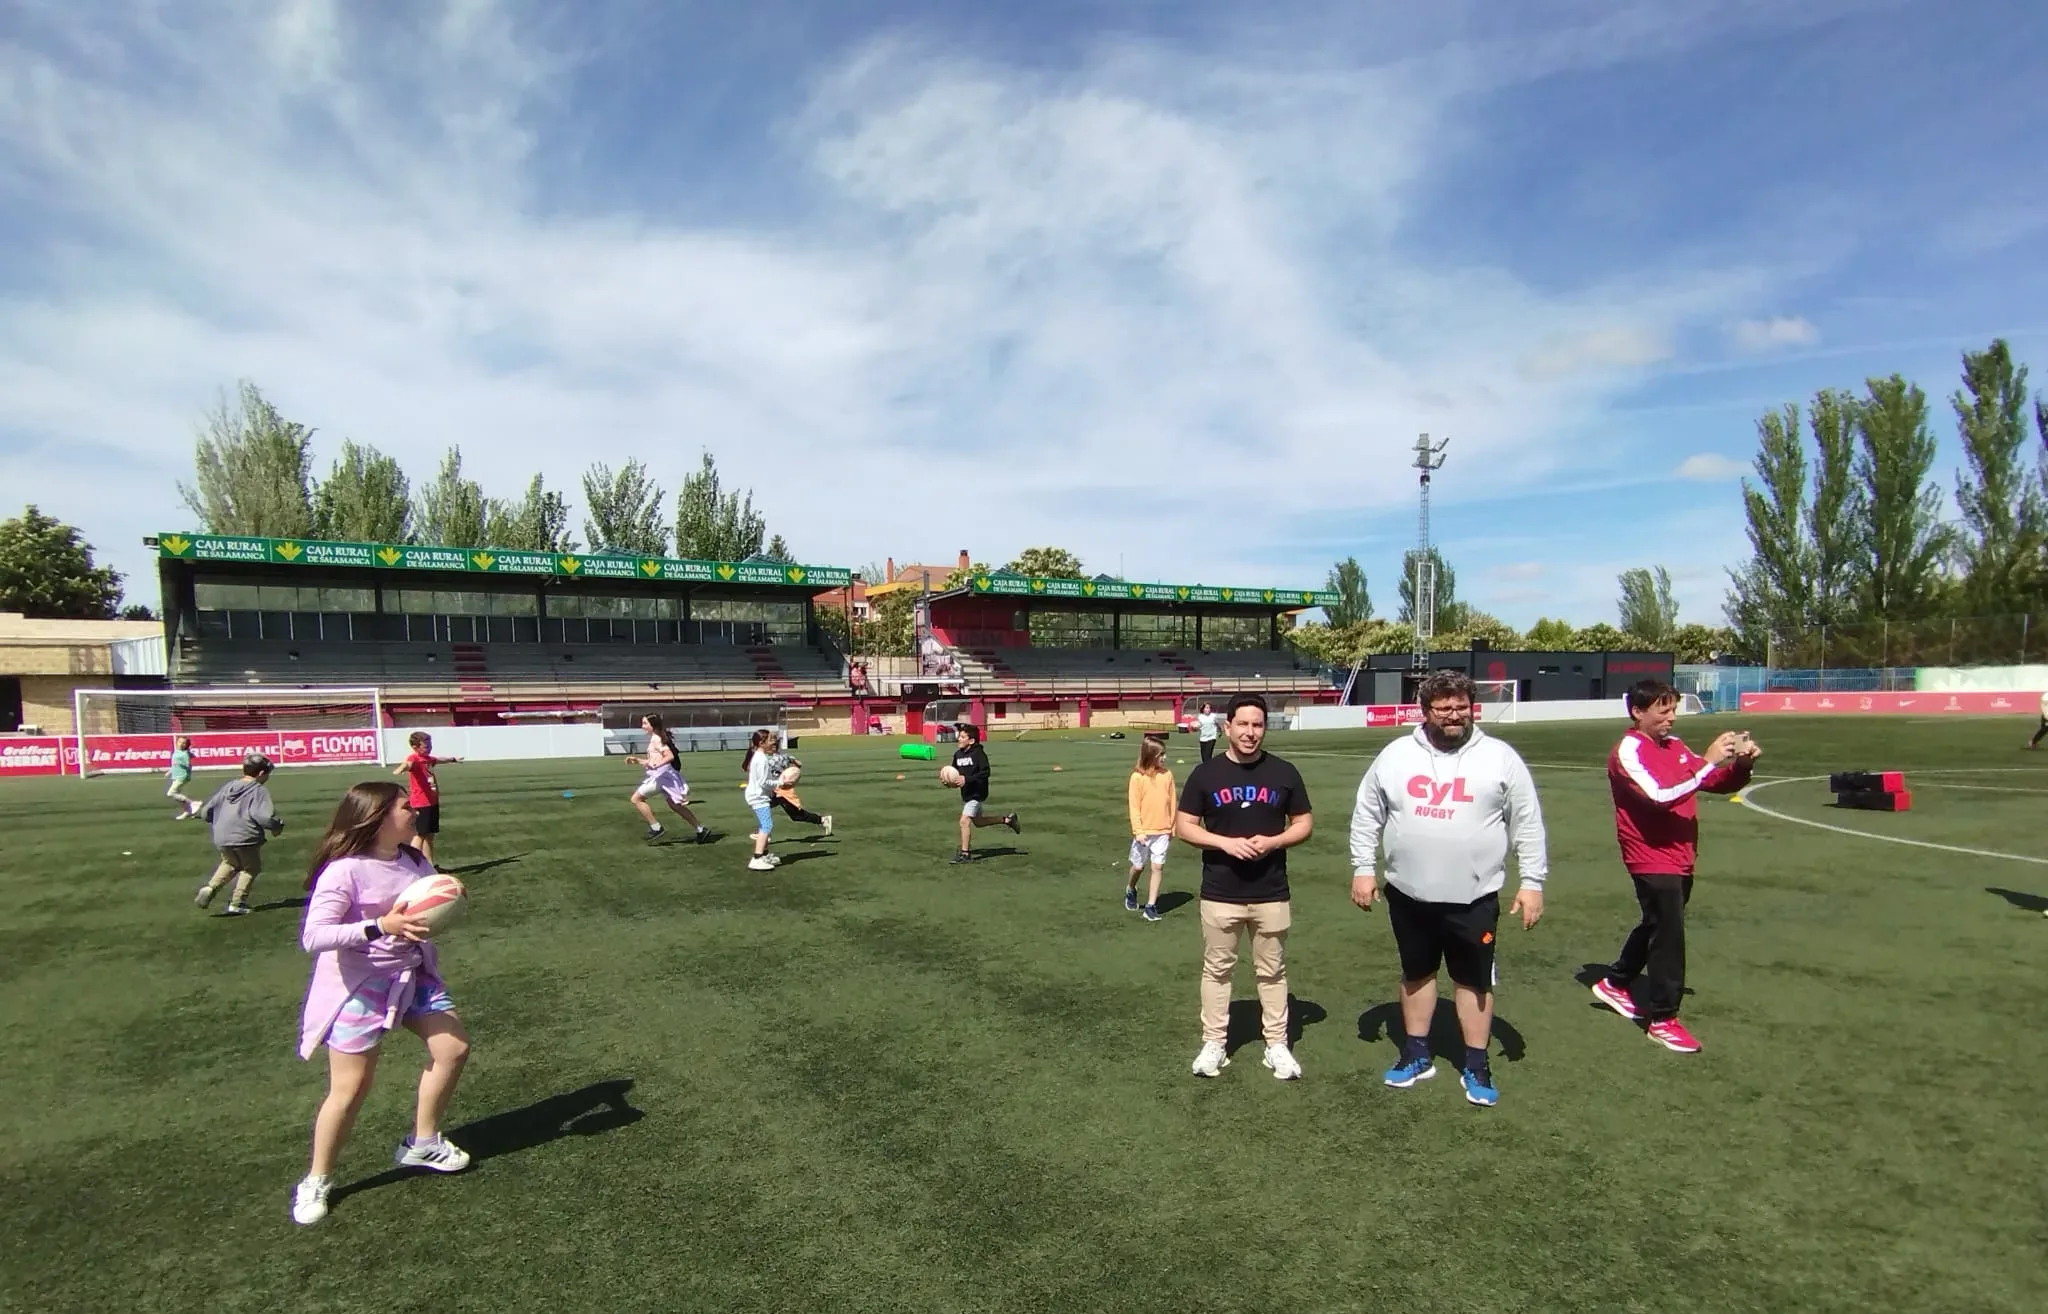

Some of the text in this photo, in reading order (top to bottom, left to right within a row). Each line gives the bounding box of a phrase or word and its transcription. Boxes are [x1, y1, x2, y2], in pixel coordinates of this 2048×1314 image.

[195, 540, 265, 552] CAJA RURAL
[196, 550, 265, 560] DE SALAMANCA
[306, 546, 370, 557] CAJA RURAL
[406, 551, 465, 562] CAJA RURAL
[320, 556, 370, 565] SALAMANCA
[418, 561, 465, 569] SALAMANCA
[498, 556, 553, 566] CAJA RURAL
[584, 560, 635, 569] CAJA RURAL
[510, 565, 553, 573] SALAMANCA
[664, 564, 712, 573] CAJA RURAL
[738, 567, 782, 577] CAJA RURAL
[807, 570, 849, 580] CAJA RURAL
[312, 736, 376, 753] FLOYMA
[92, 748, 171, 762] la rivera
[1213, 785, 1280, 807] JORDAN
[1415, 806, 1455, 820] RUGBY
